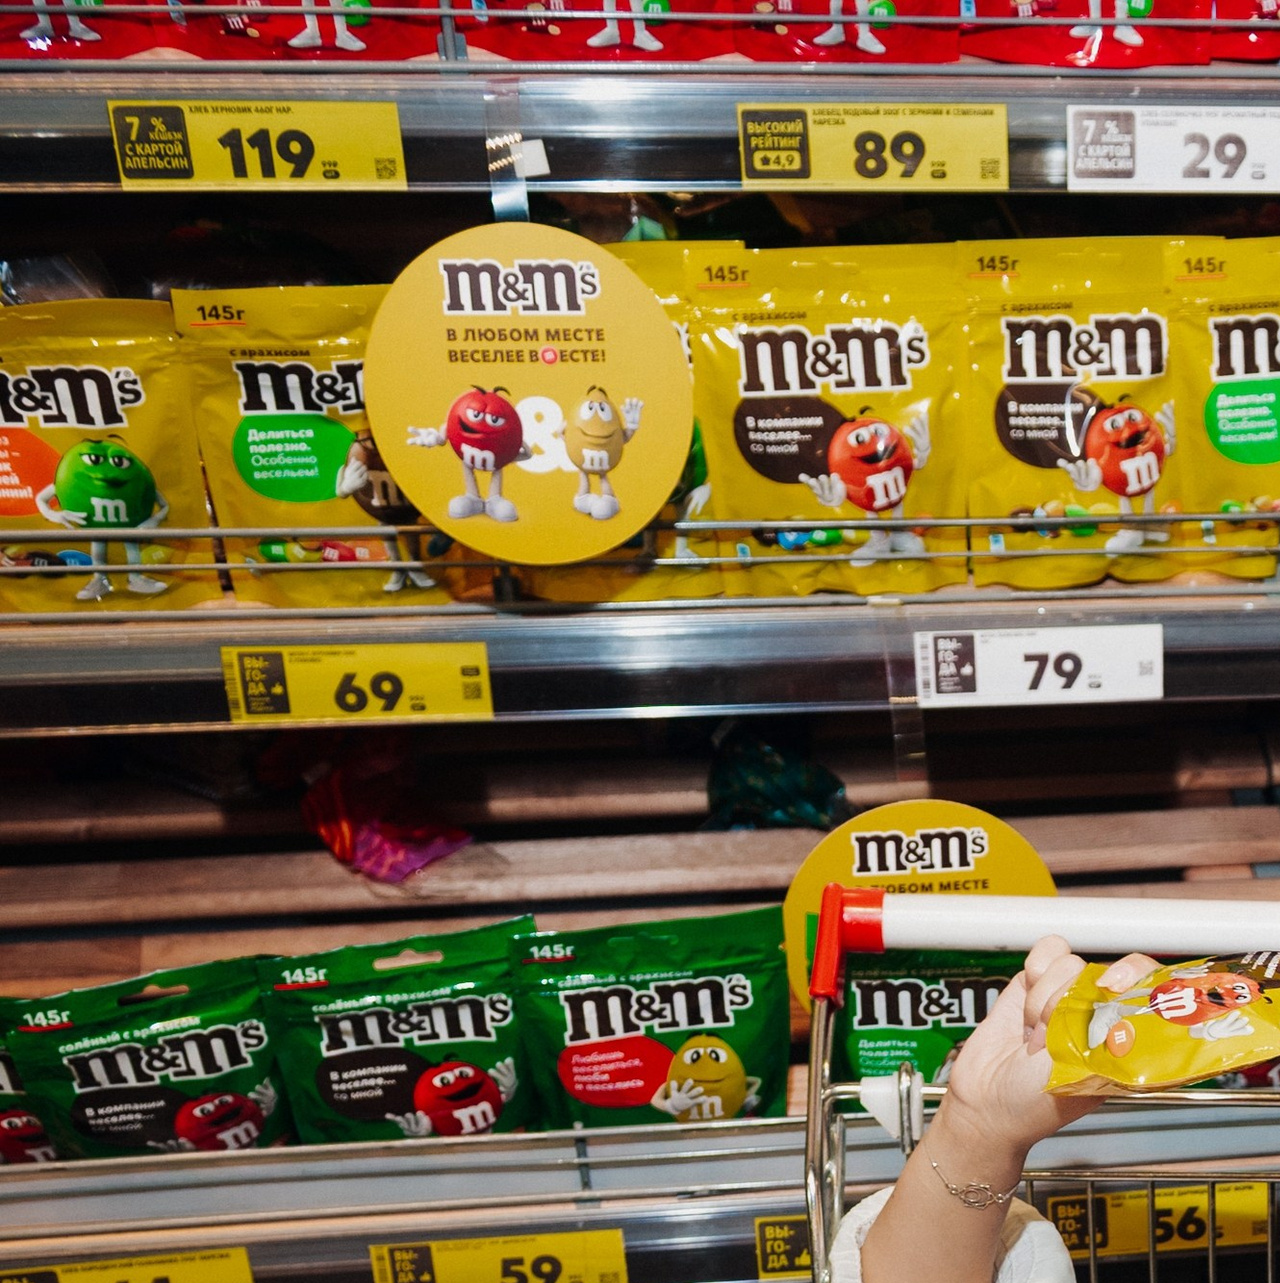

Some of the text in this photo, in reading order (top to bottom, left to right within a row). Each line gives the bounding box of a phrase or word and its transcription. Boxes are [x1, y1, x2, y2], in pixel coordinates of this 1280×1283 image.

[188, 106, 209, 115] ХЛЕБ
[210, 106, 253, 115] ЗЕРНОВИК
[125, 116, 166, 141] 7 %
[747, 118, 803, 134] ВЫСОКИЙ
[1083, 119, 1097, 143] 7
[125, 141, 183, 156] С КАРТОЙ
[750, 134, 802, 149] РЕЙТИНГ
[217, 127, 316, 179] 119
[854, 130, 926, 179] 89
[1088, 143, 1131, 157] КАРТОЙ
[1182, 132, 1247, 179] 29
[125, 156, 189, 170] АПЕЛЬСИН
[773, 154, 795, 168] 4,9
[1076, 158, 1133, 170] АПЕЛЬСИН
[977, 256, 1019, 272] 145г
[1185, 257, 1227, 273] 145г
[704, 265, 750, 282] 145г
[442, 262, 599, 313] m&m's
[197, 305, 245, 321] 145г
[742, 311, 808, 323] арахисом
[446, 328, 605, 342] В ЛЮБОМ МЕСТЕ
[240, 348, 311, 360] арахисом
[448, 349, 525, 363] ВЕСЕЛЕЕ
[738, 326, 926, 392] m&ms
[746, 416, 823, 429] В компании
[248, 428, 314, 442] Делиться
[250, 443, 311, 453] полезно.
[251, 454, 317, 467] Особенно
[254, 466, 319, 480] весельем!
[1023, 652, 1083, 690] 79
[335, 671, 404, 713] 69
[855, 829, 985, 873] m&m's
[939, 879, 989, 891] МЕСТЕ
[529, 945, 575, 959] 145г
[281, 967, 328, 984] 145г
[563, 974, 751, 1043] m&m's
[23, 1010, 71, 1027] 145г
[318, 992, 512, 1052] m&m's
[58, 1031, 121, 1054] солёный
[67, 1019, 266, 1090] m&m's
[1057, 1204, 1086, 1218] ВЫ-
[765, 1225, 795, 1239] ВЫ-
[1155, 1206, 1207, 1243] 56
[766, 1240, 791, 1253] ГО-
[767, 1254, 789, 1269] ДА
